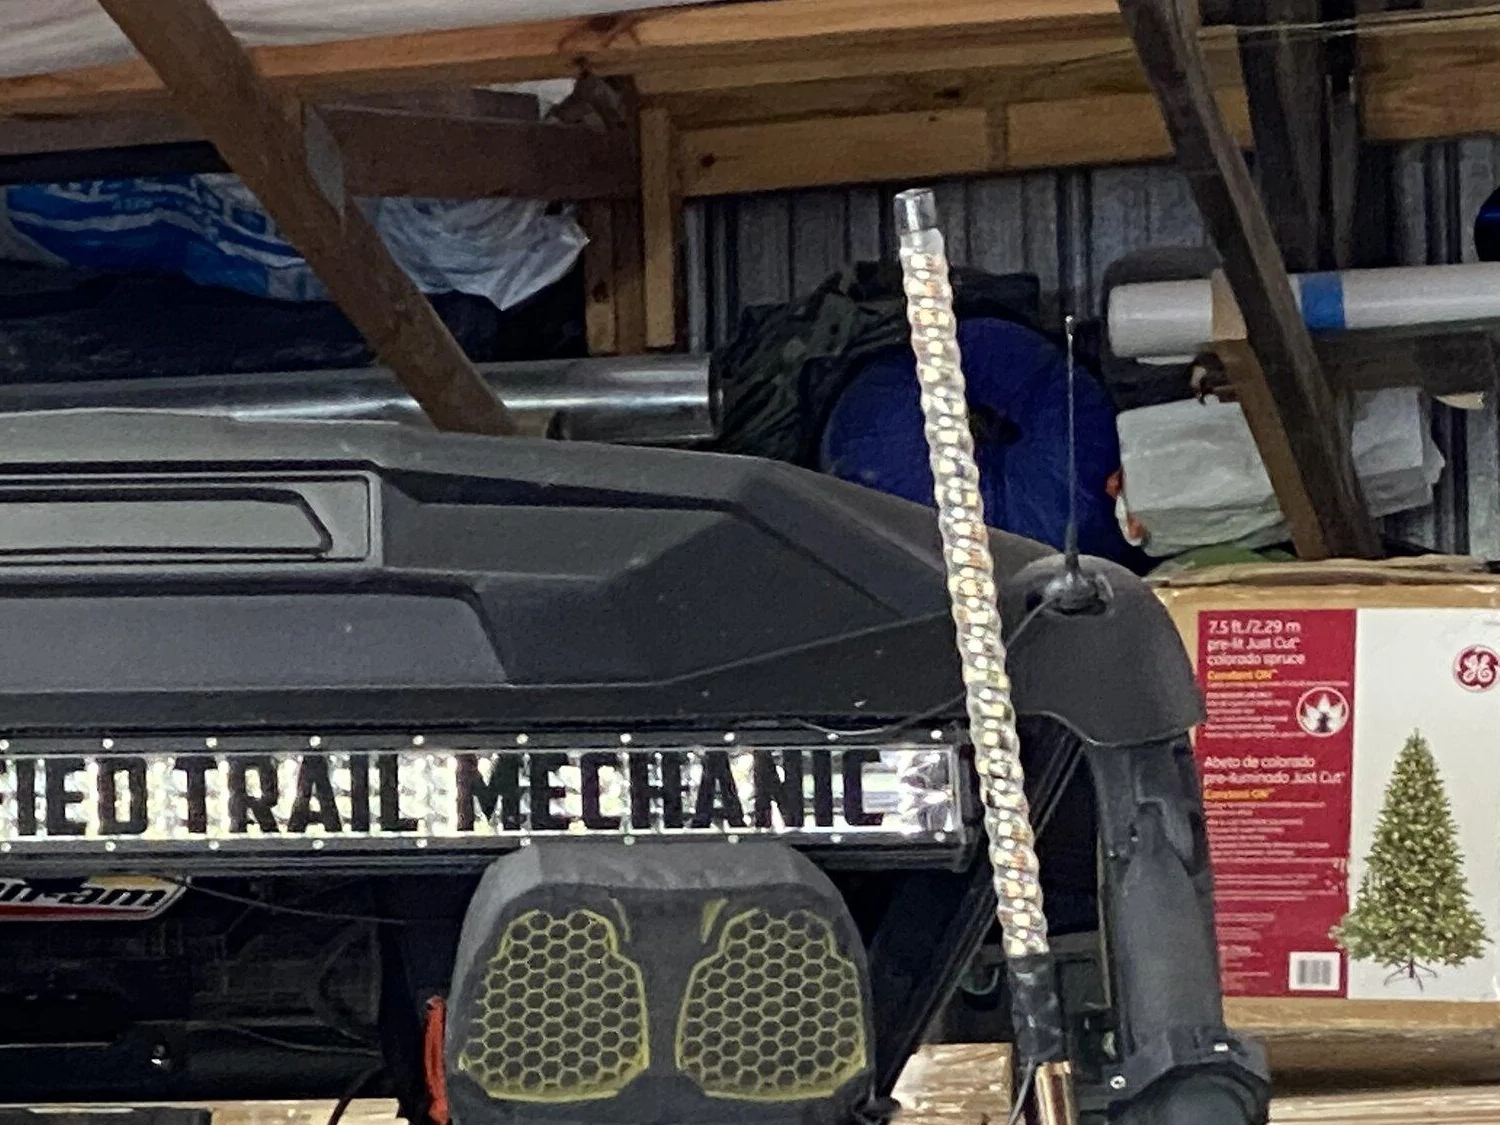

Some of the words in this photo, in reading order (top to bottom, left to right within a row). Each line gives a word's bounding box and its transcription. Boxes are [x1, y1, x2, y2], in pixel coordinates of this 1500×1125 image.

[1285, 621, 1301, 632] m
[1207, 652, 1261, 665] colorado
[1263, 653, 1306, 667] spruce
[174, 752, 422, 835] TRAIL
[455, 747, 885, 832] MECHANIC
